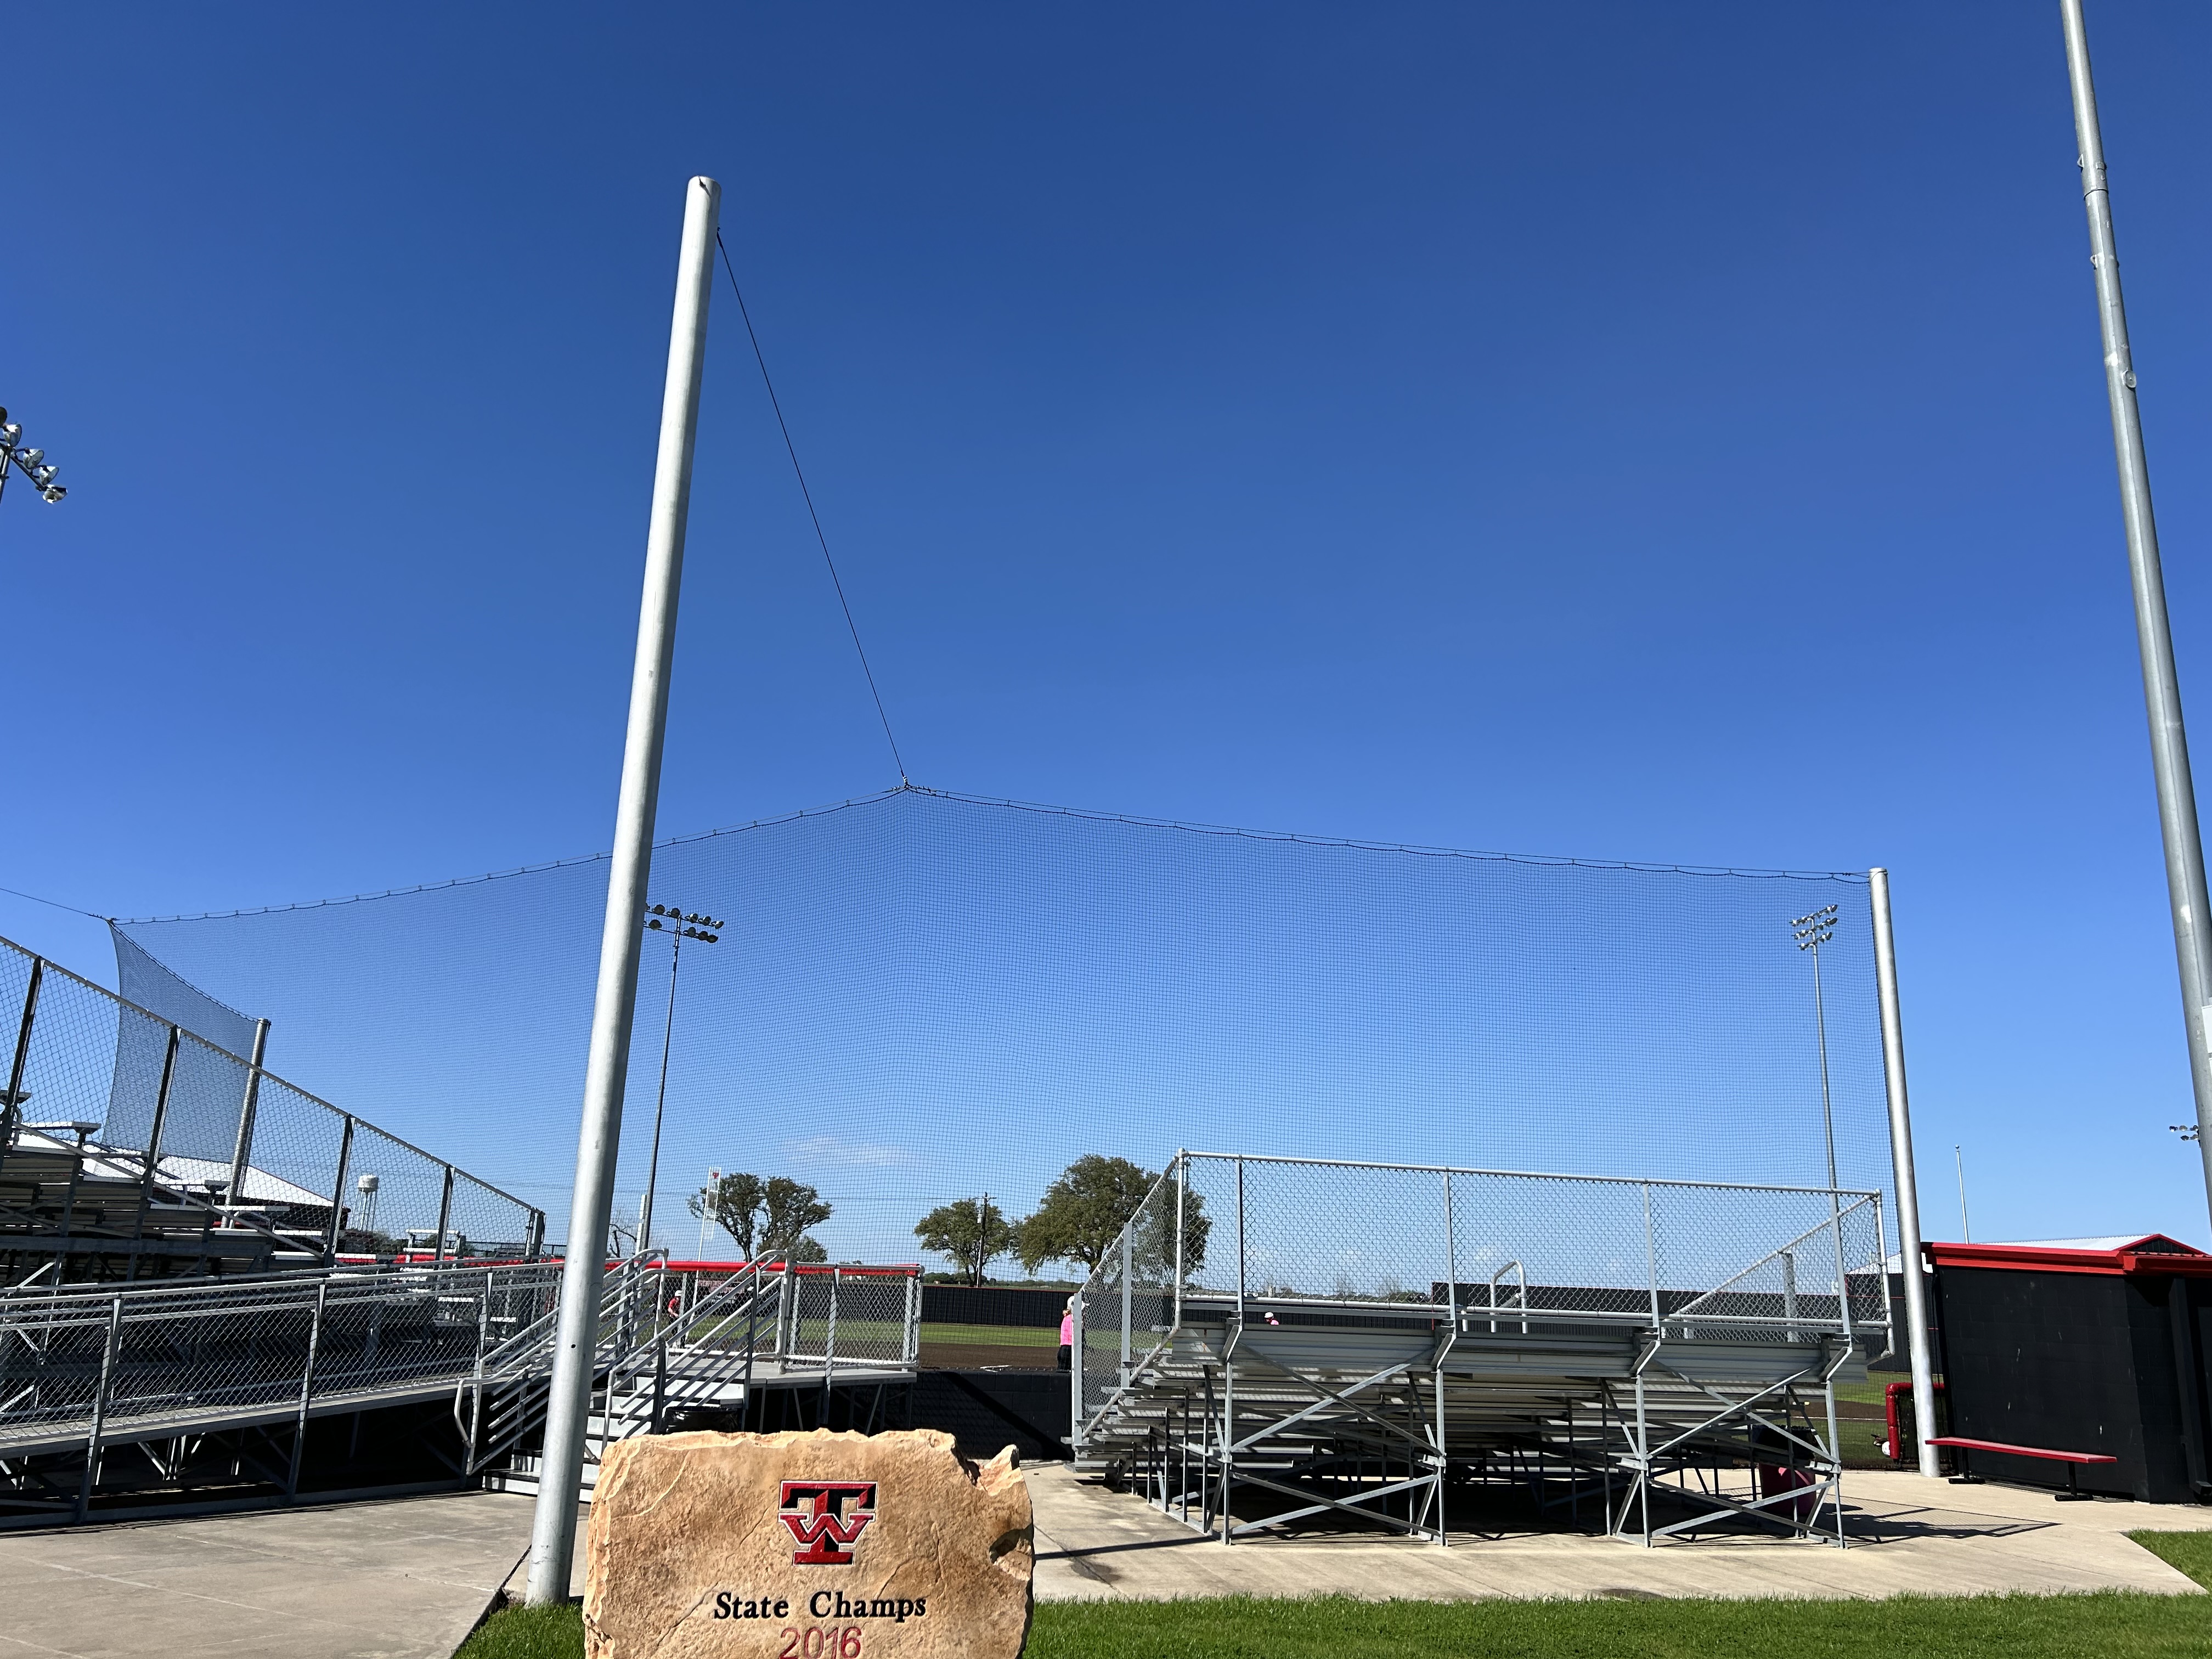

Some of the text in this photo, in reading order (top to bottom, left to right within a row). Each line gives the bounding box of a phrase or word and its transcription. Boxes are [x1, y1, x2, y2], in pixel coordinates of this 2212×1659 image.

[714, 1591, 926, 1622] State Champs
[778, 1627, 862, 1659] 2016
